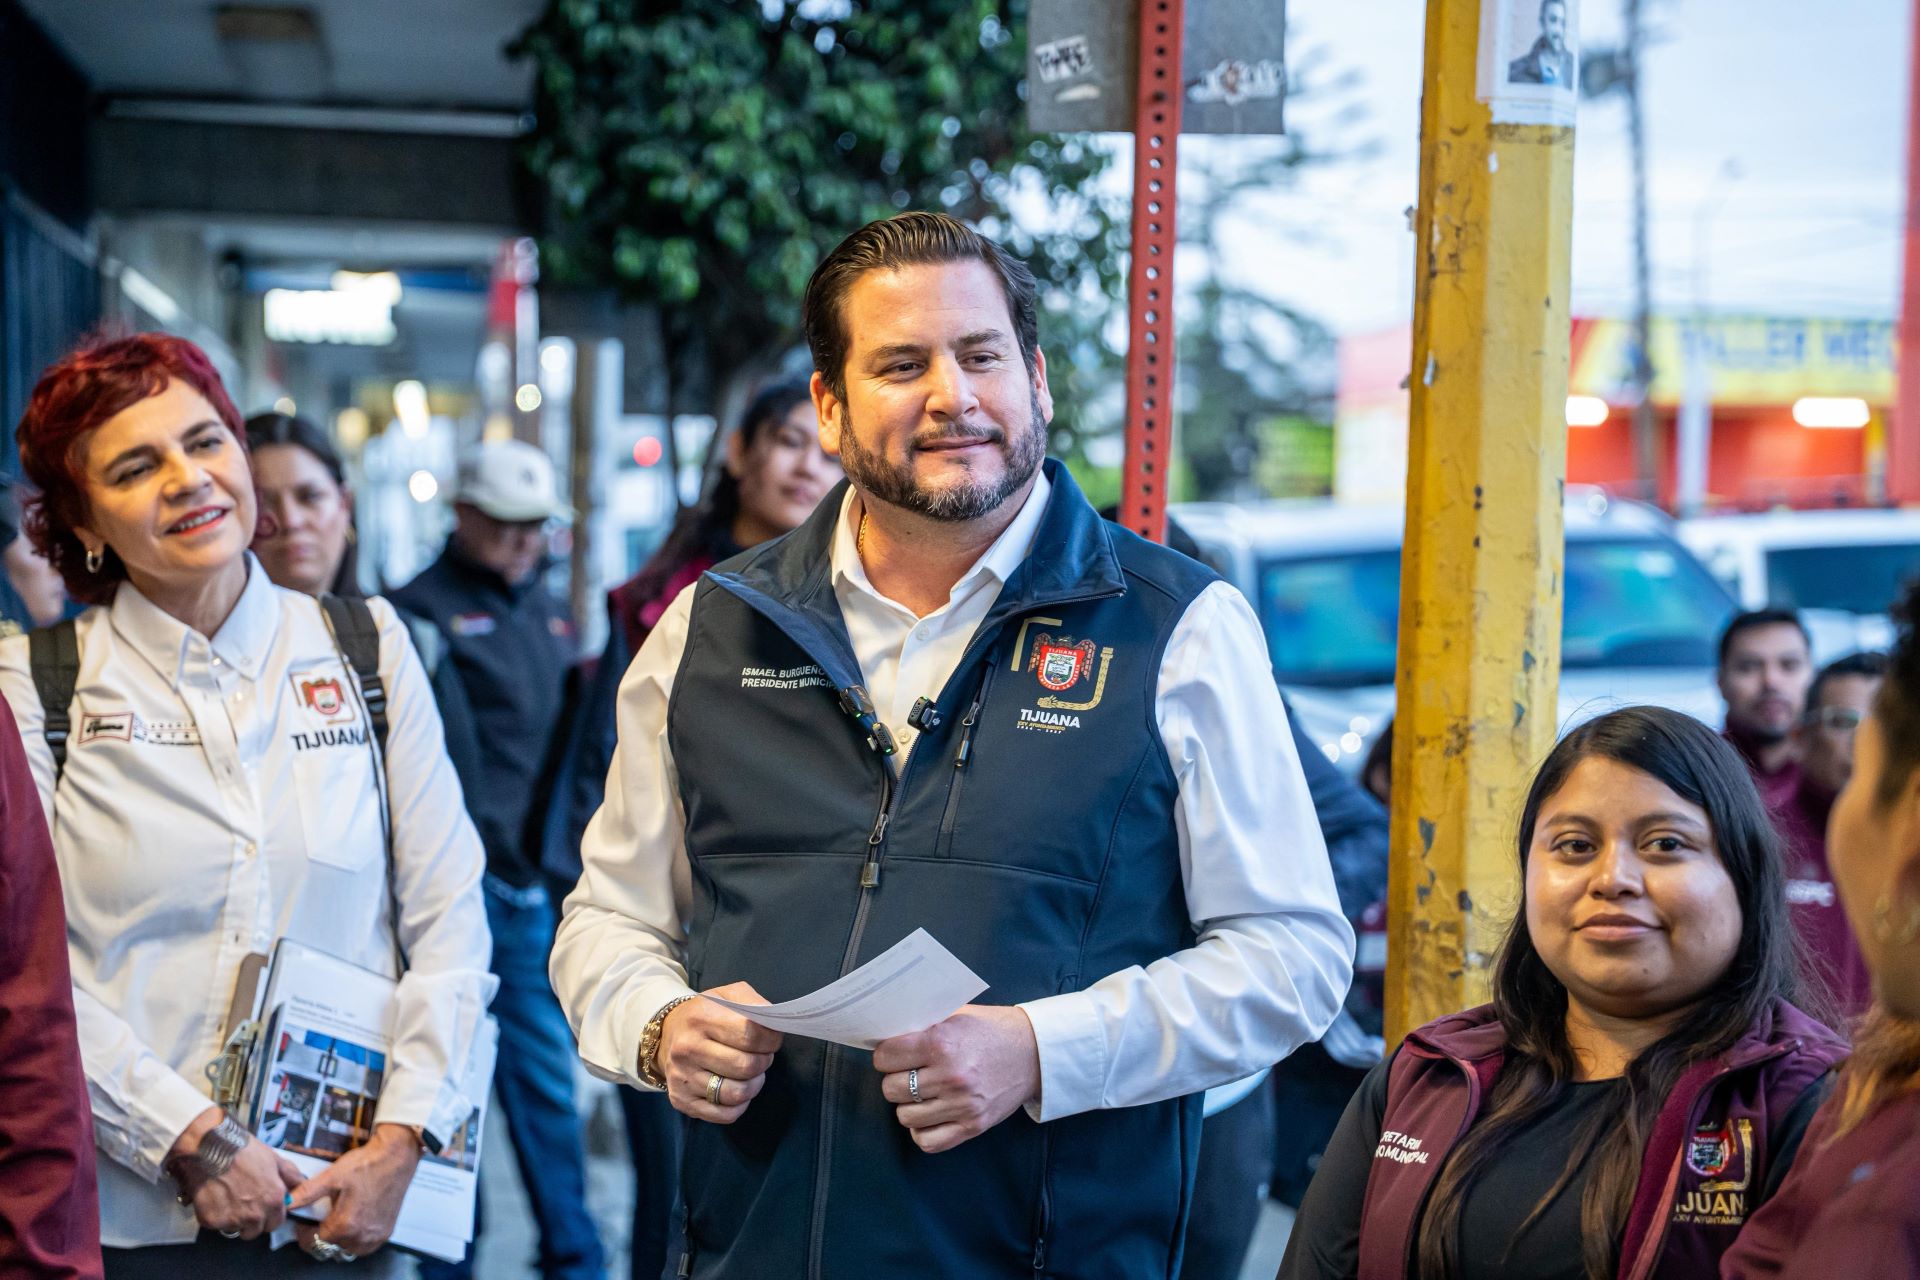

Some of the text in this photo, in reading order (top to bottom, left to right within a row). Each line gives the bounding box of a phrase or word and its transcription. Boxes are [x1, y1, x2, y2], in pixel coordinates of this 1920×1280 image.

[741, 667, 777, 678] ISMAEL
[741, 677, 798, 690] PRESIDENTE
[1020, 708, 1081, 729] TIJUANA
